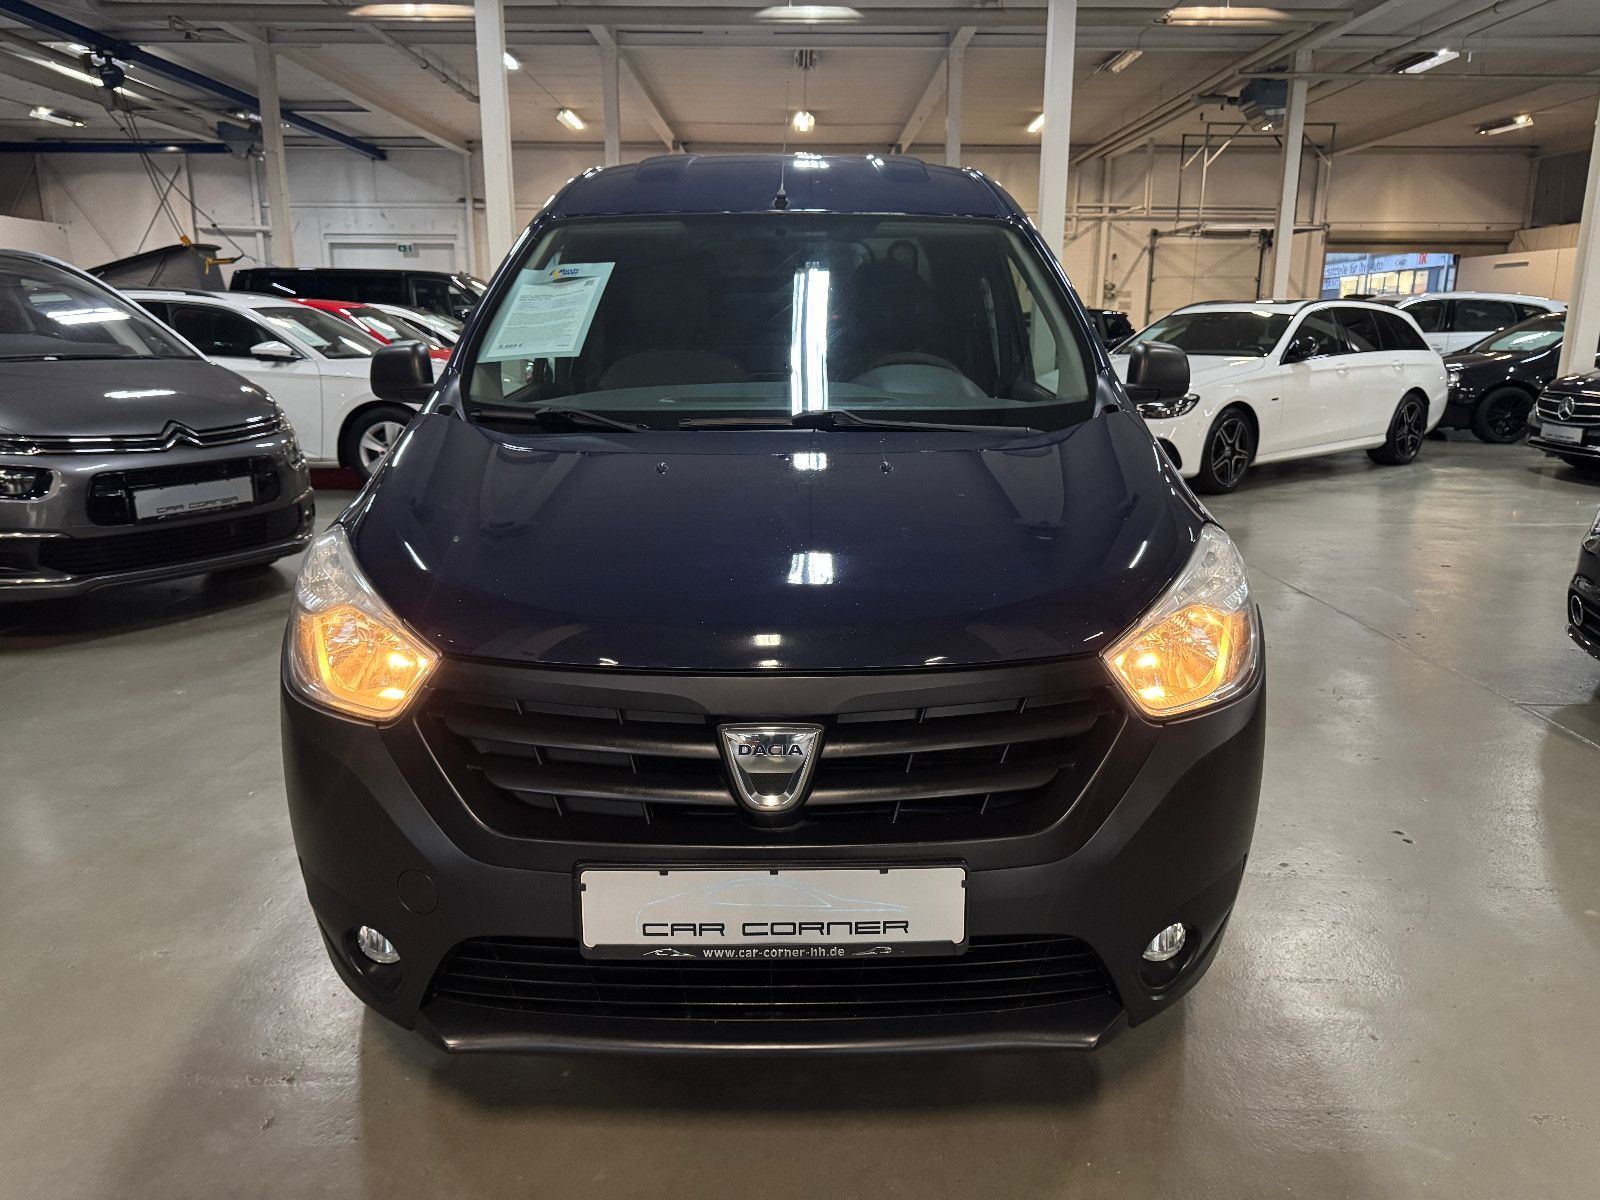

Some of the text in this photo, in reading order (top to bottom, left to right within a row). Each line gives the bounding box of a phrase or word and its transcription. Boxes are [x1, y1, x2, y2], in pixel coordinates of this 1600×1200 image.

[738, 743, 804, 756] DACIA
[641, 920, 909, 937] CAR CORNER
[702, 946, 846, 959] www.car-corner-hh.de
